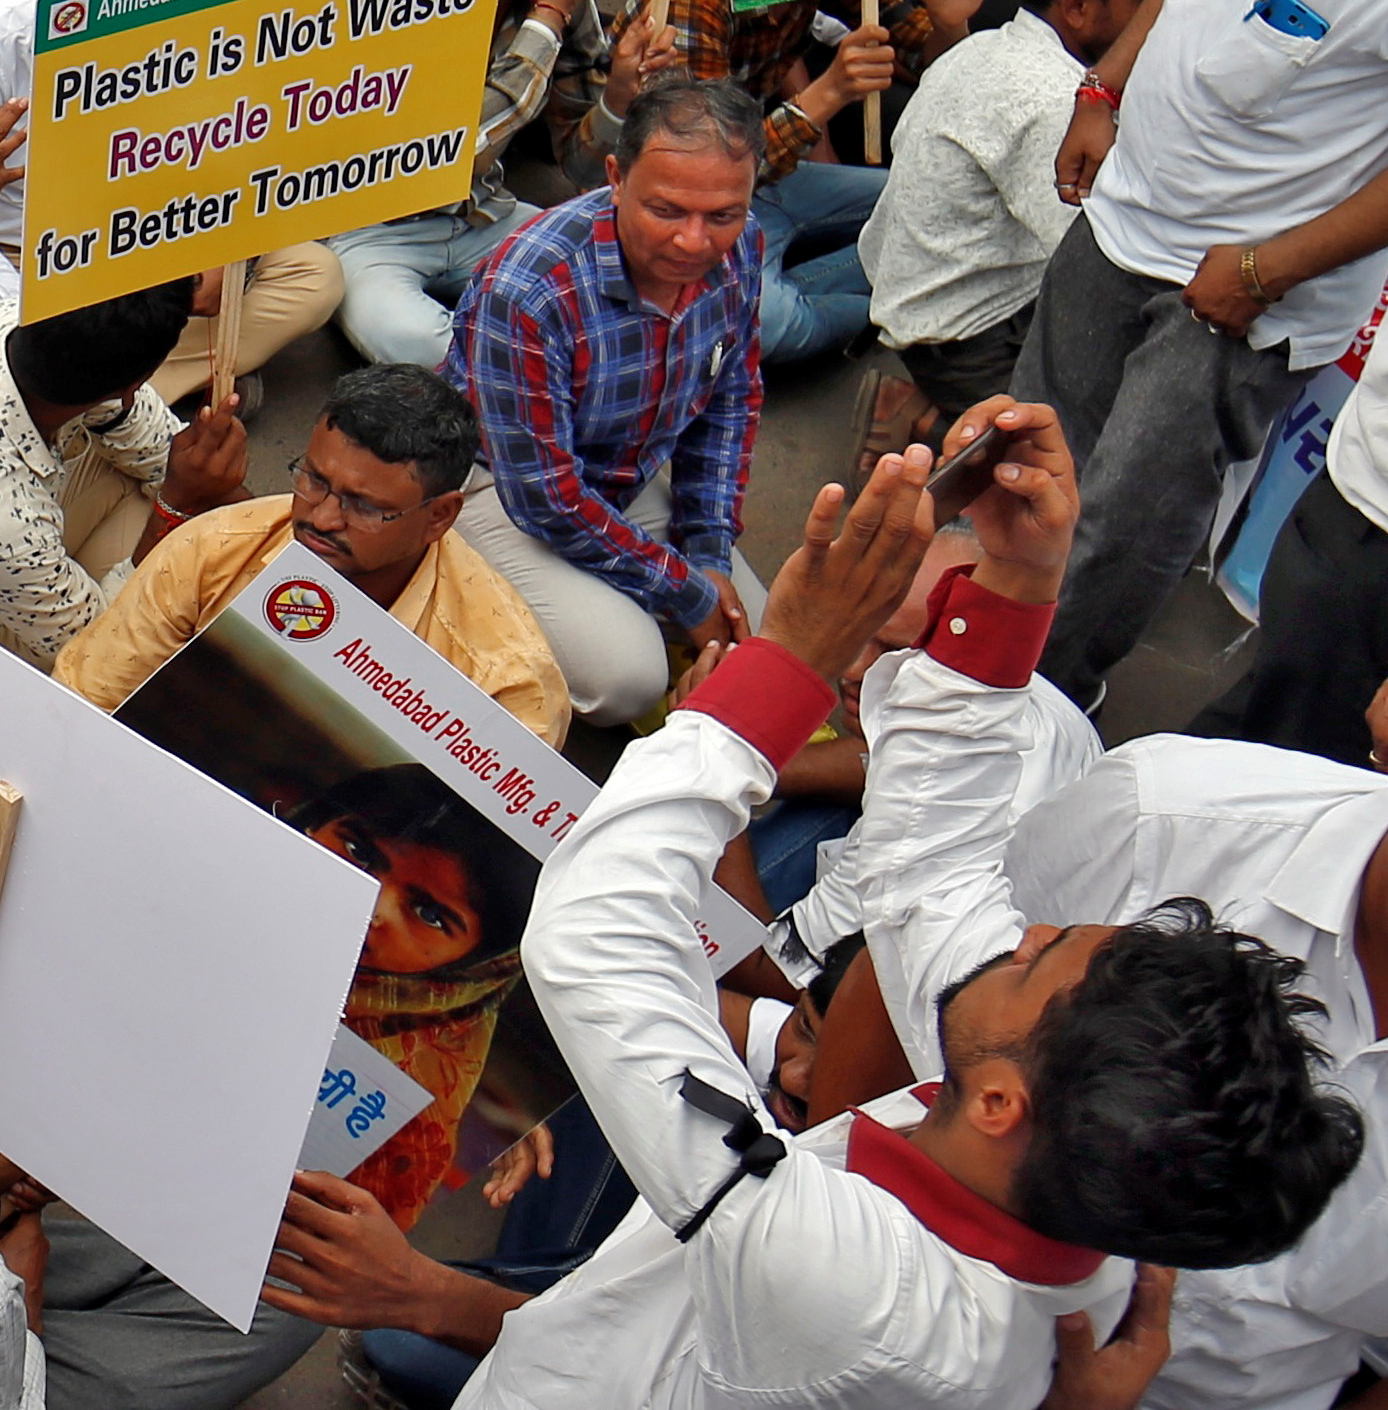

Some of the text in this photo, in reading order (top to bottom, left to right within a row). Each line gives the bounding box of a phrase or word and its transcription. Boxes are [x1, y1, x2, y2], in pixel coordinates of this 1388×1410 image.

[54, 39, 197, 119] Plastic
[206, 28, 242, 76] is
[255, 6, 336, 65] Not
[107, 64, 413, 182] Recycle Today
[36, 128, 466, 277] for Better Tomorrow
[290, 606, 314, 614] PLASTIC
[334, 639, 560, 828] Ahmedabad Plastic Mfg. &
